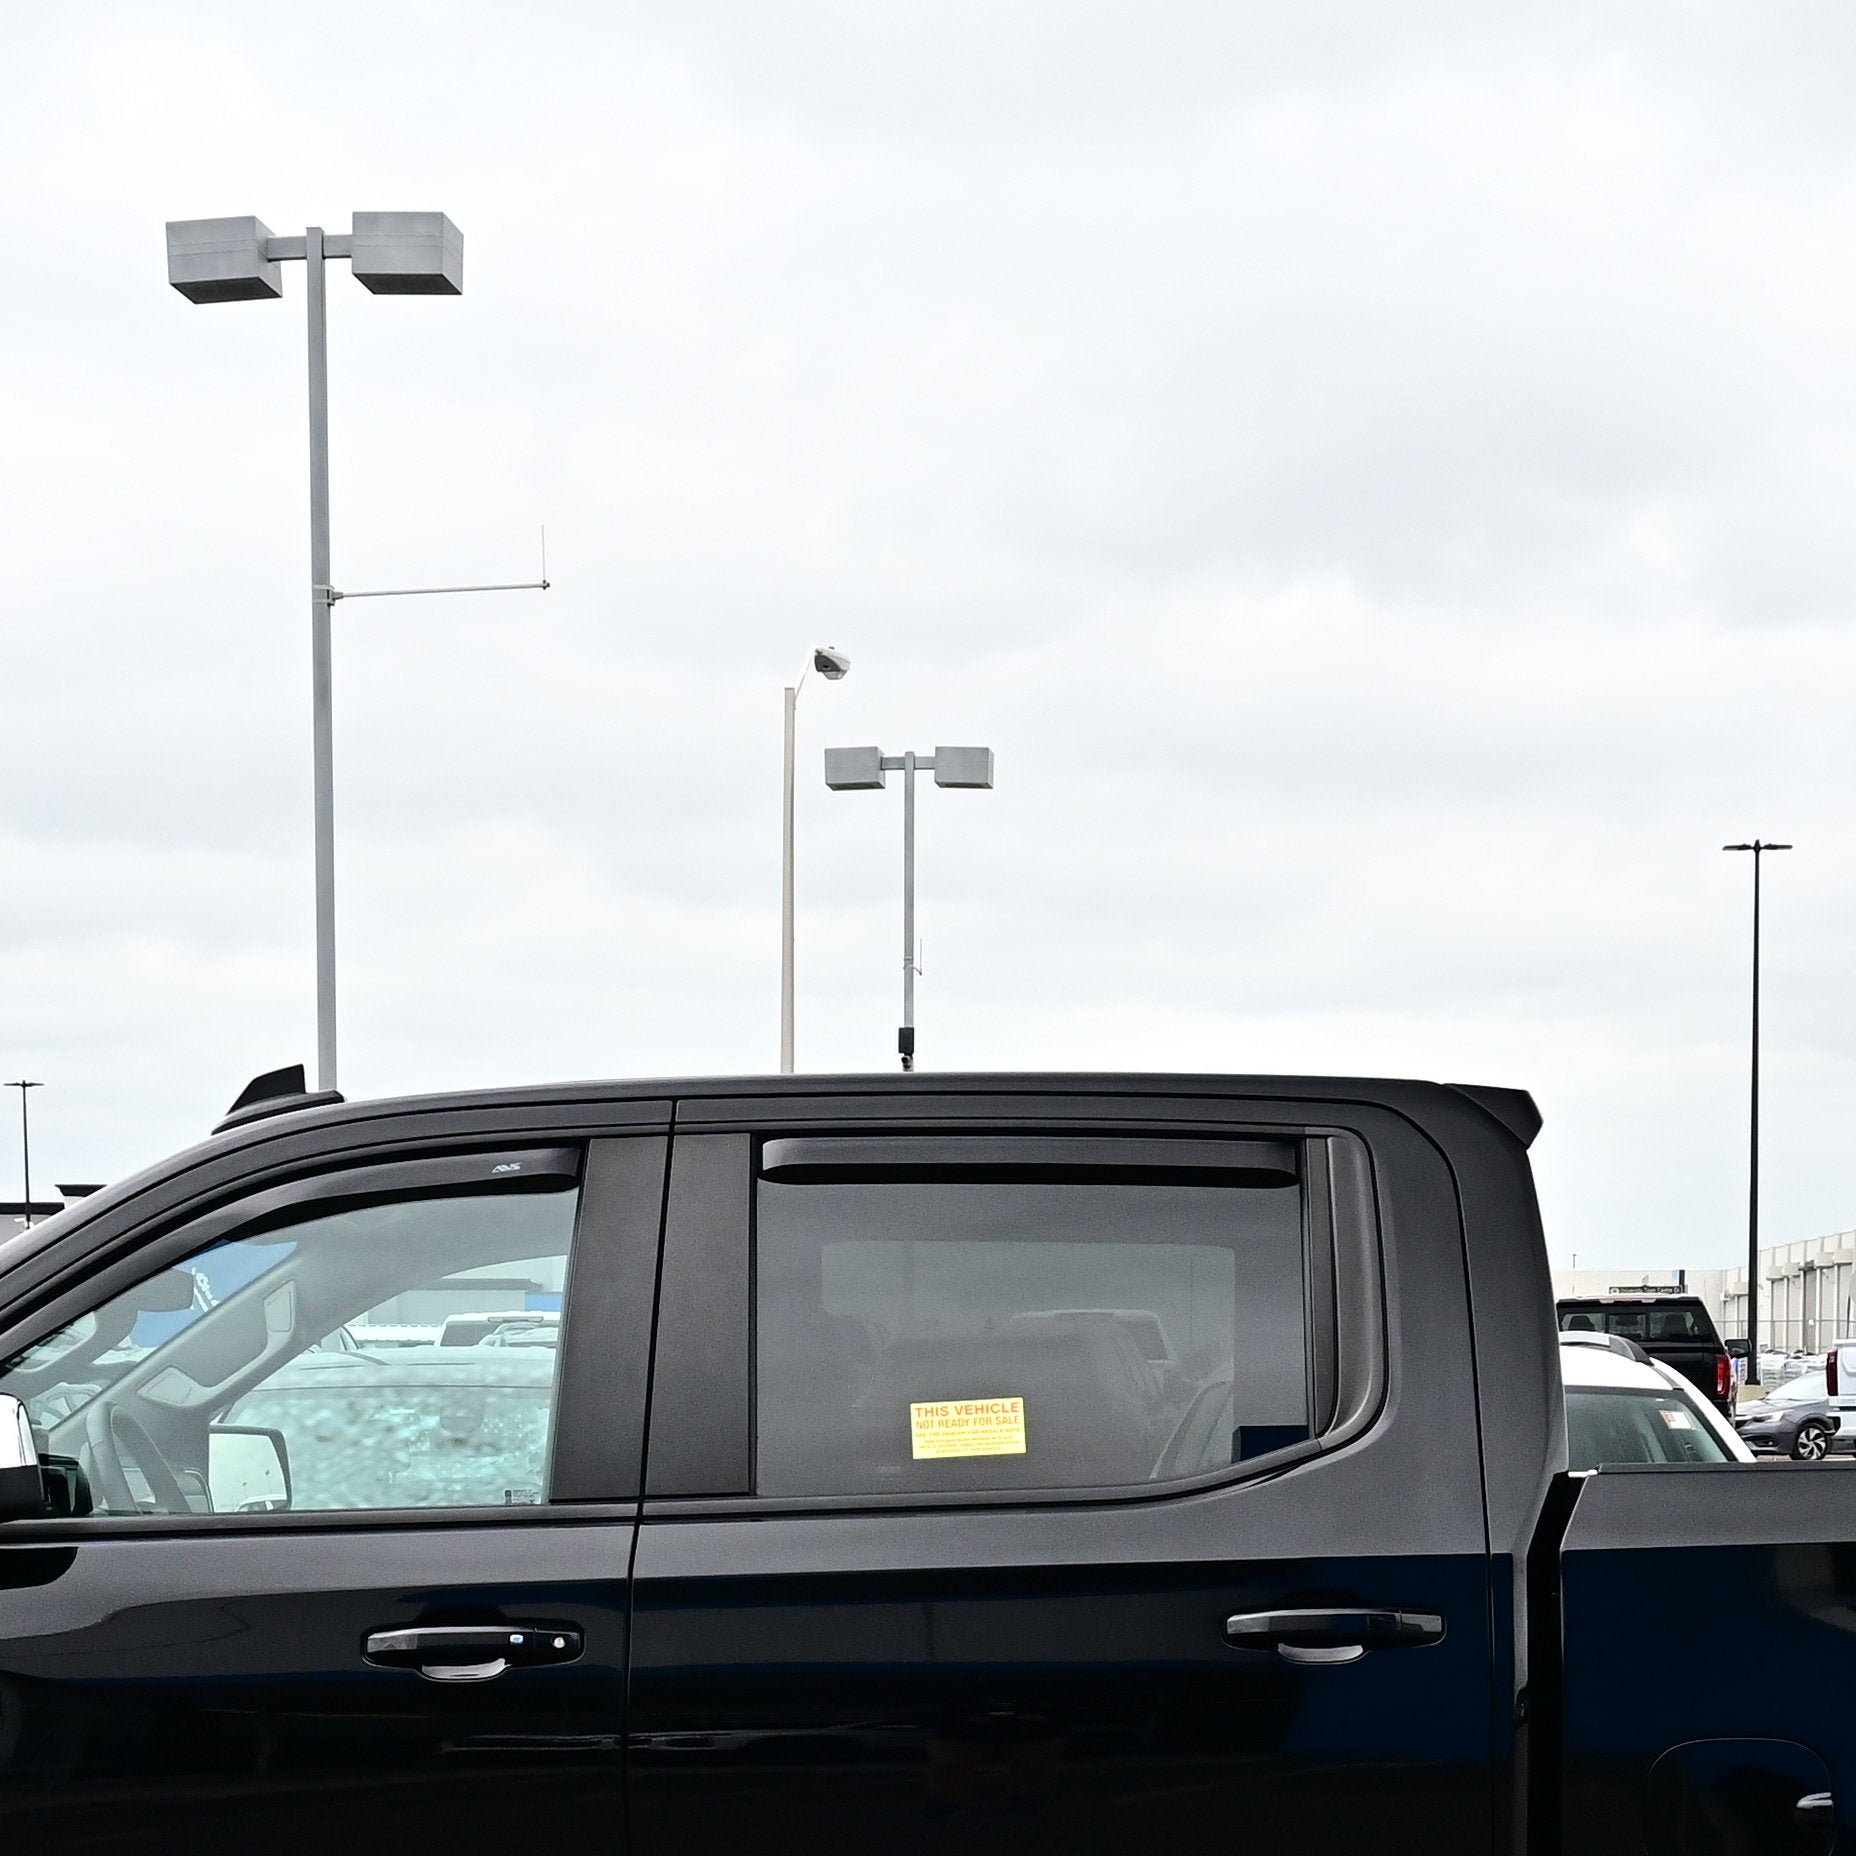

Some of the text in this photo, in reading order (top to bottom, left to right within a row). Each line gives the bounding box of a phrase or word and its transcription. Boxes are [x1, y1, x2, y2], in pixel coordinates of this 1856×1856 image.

[915, 1402, 1019, 1417] THIS VEHICLE
[916, 1415, 1019, 1429] NOT READY FOR SALE
